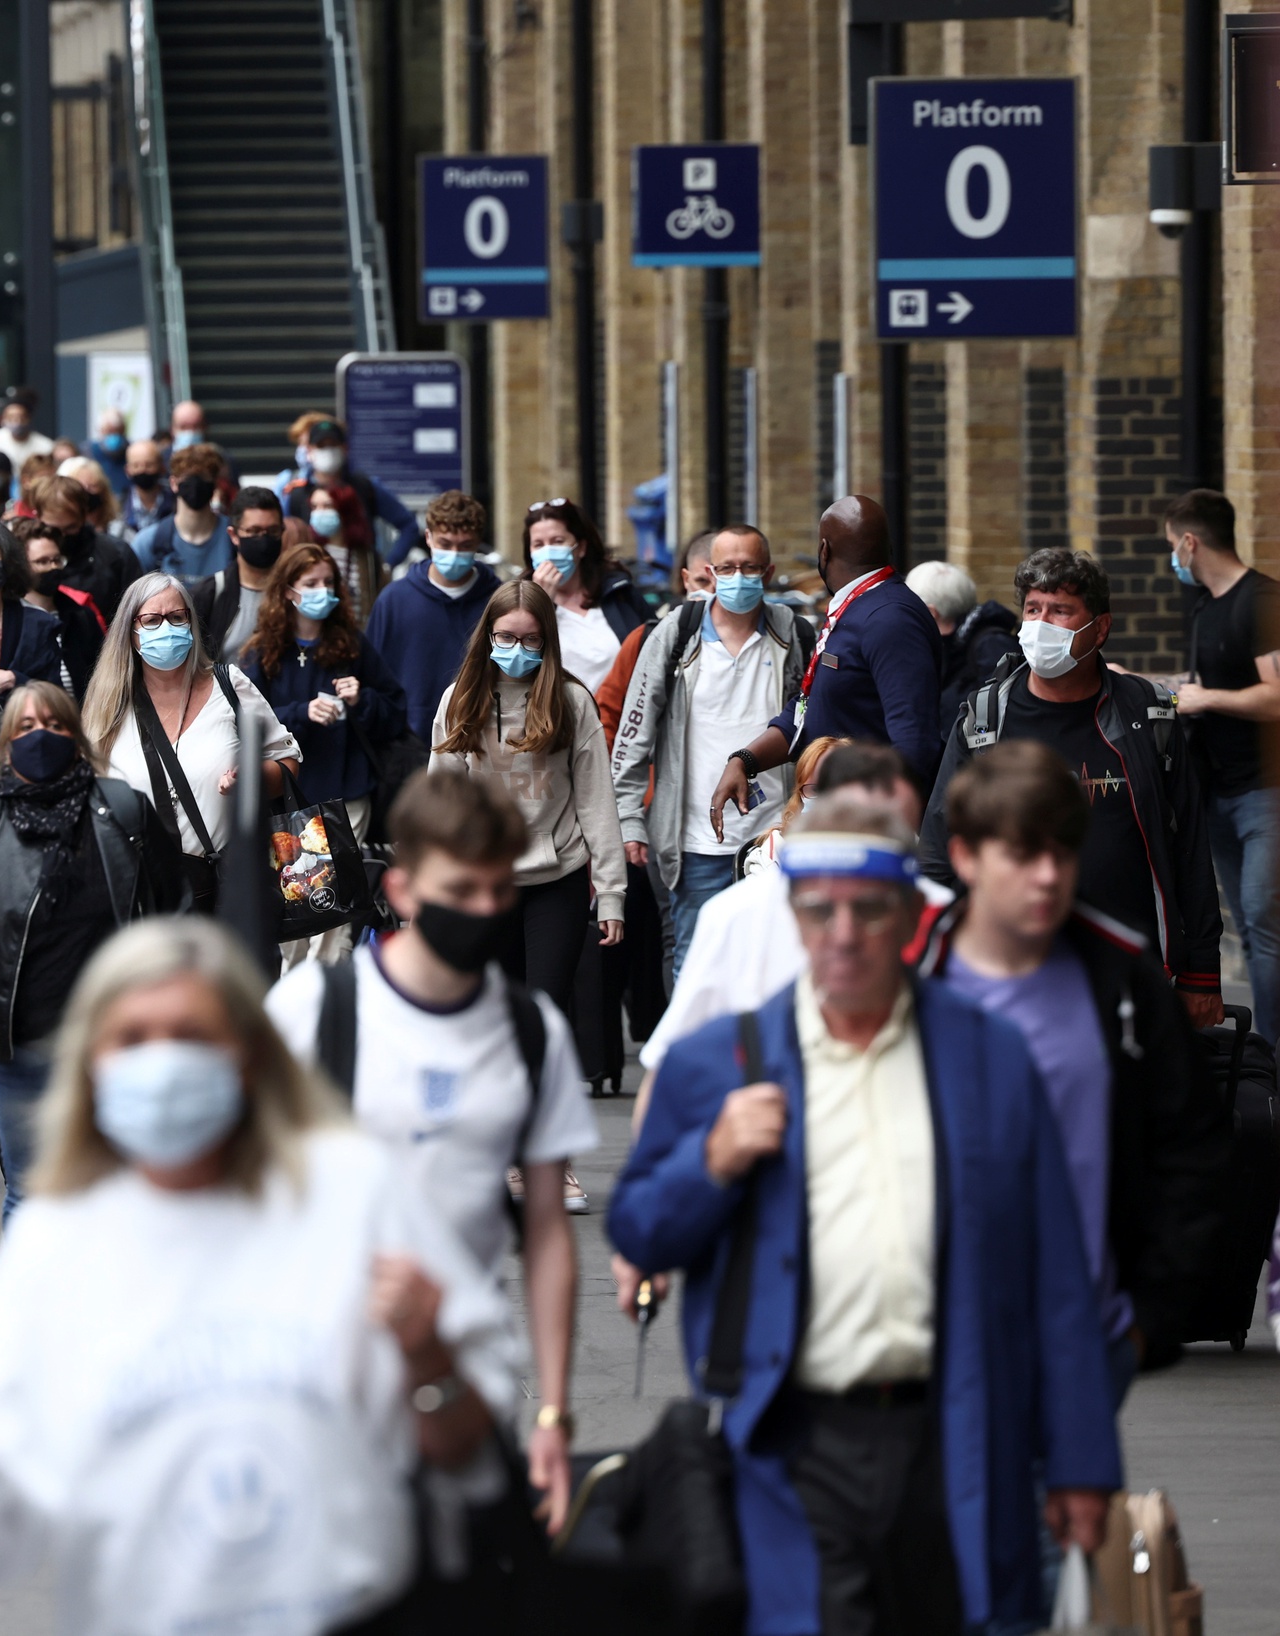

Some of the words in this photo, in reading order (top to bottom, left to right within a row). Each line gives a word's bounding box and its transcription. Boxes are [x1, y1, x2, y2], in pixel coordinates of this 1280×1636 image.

[913, 98, 1043, 127] Platform
[443, 167, 529, 189] Platform
[945, 144, 1011, 239] 0
[464, 195, 509, 259] 0
[622, 710, 644, 740] 58
